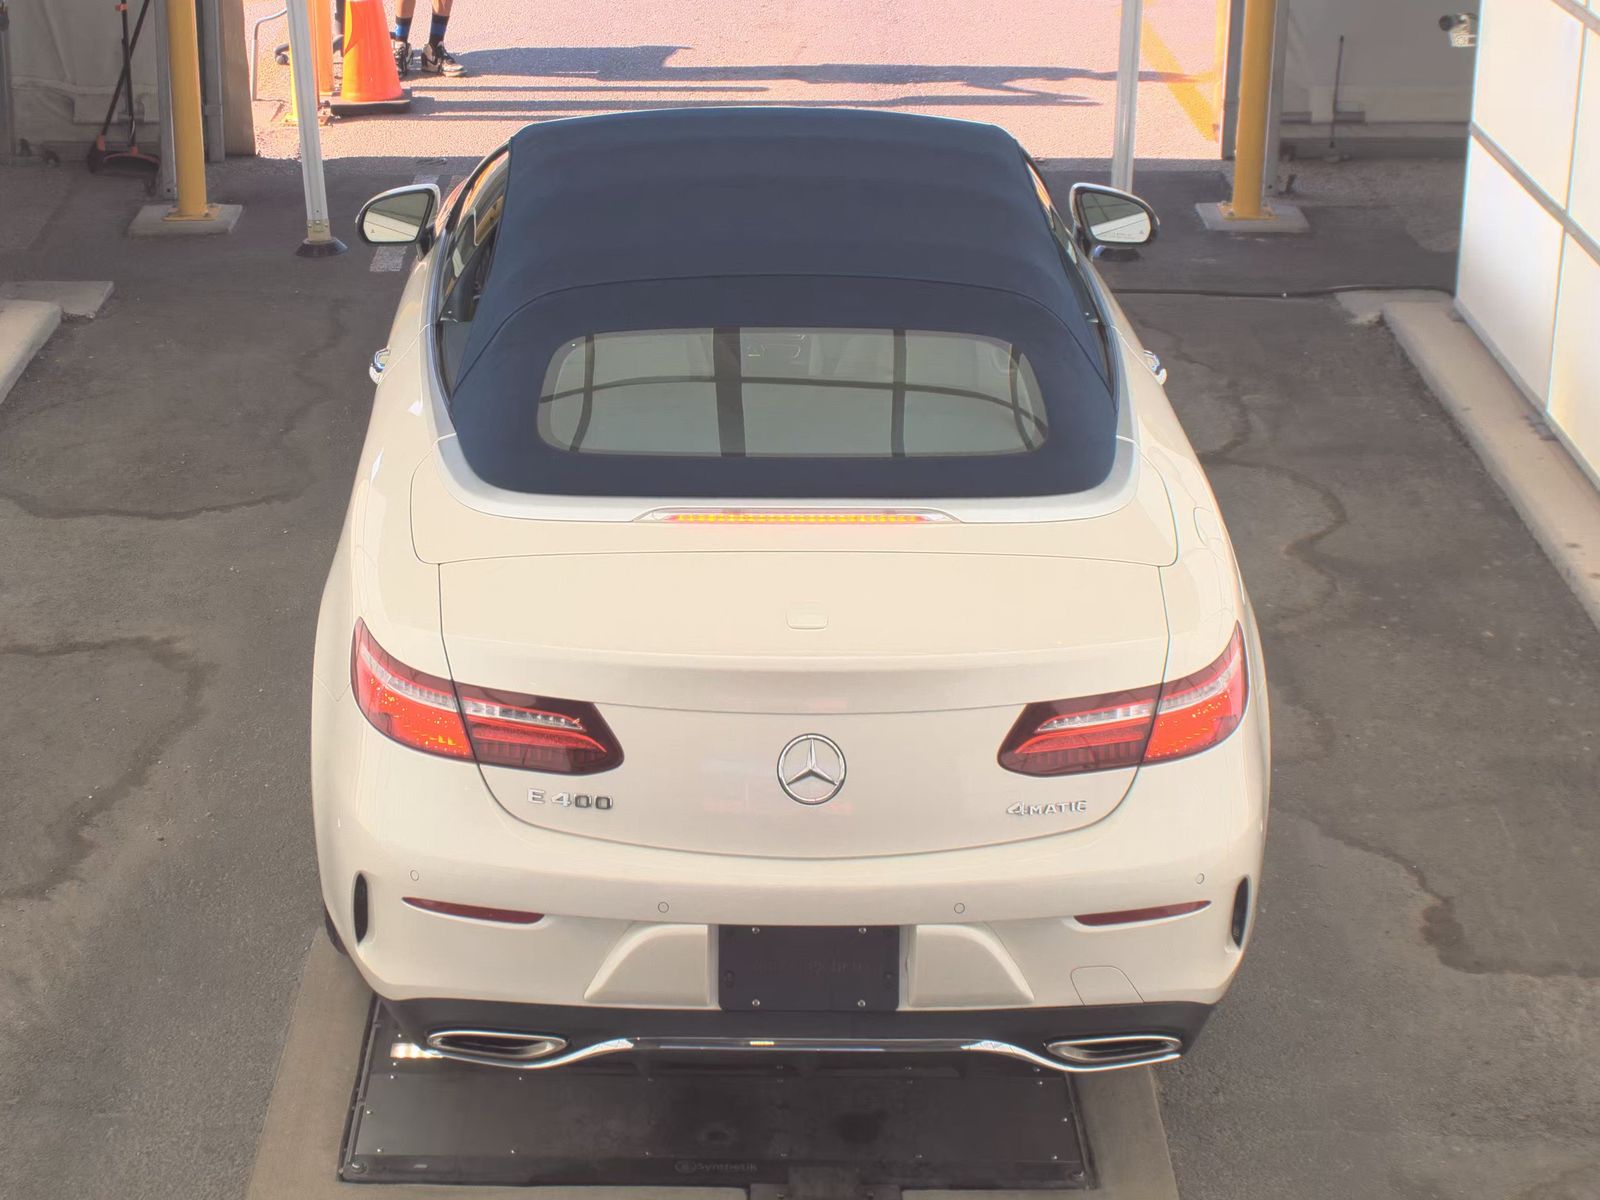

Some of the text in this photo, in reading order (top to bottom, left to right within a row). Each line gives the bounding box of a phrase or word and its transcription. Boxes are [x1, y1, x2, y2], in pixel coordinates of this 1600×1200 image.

[527, 787, 613, 810] E 400
[1006, 799, 1087, 816] 4MATIC
